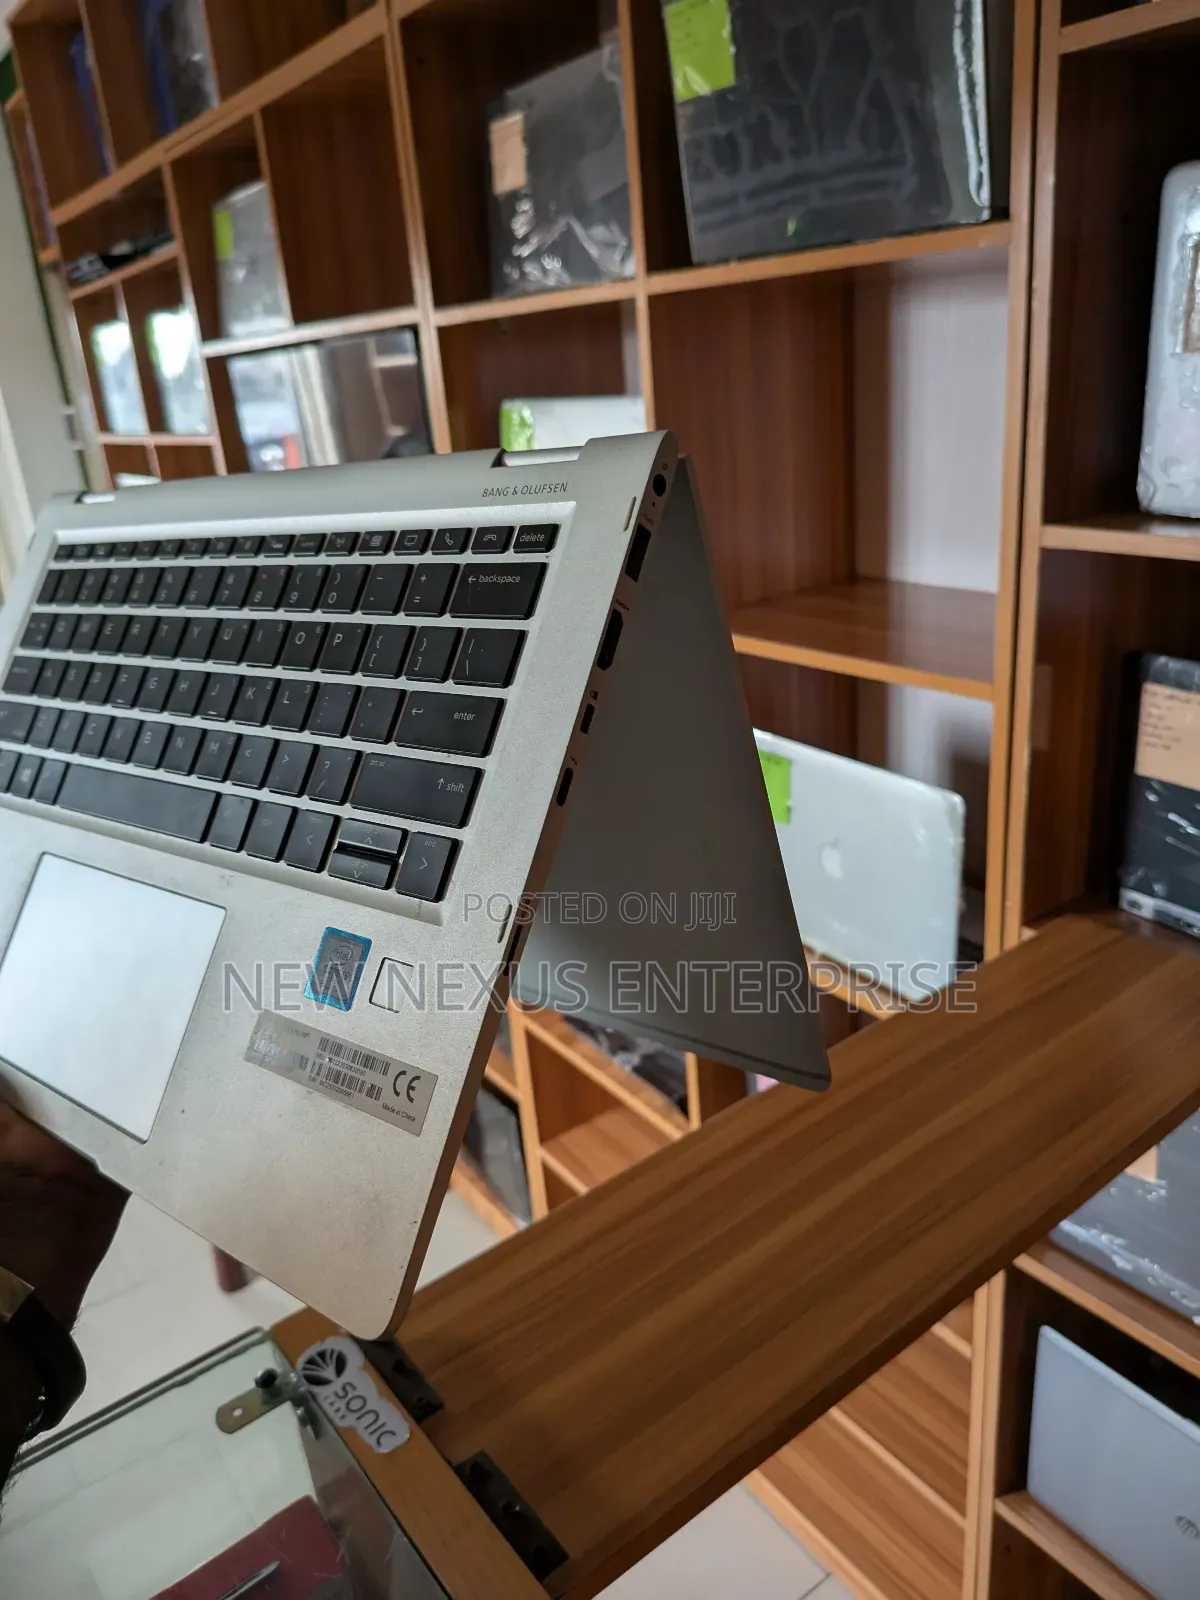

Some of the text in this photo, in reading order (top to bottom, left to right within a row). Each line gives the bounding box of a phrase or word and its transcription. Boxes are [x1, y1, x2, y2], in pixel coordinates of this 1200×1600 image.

[482, 482, 568, 497] BANG & OLUFSEN
[520, 533, 545, 542] delete
[478, 574, 521, 585] backspace
[289, 592, 298, 603] 9
[224, 628, 234, 641] U
[333, 633, 343, 646] P
[369, 653, 377, 667] [
[413, 656, 422, 671] ]
[211, 683, 220, 696] J
[246, 686, 256, 699] K
[283, 690, 290, 704] L
[453, 711, 476, 721] enter
[446, 782, 465, 793] shift
[382, 1103, 396, 1114] Made
[401, 1111, 416, 1122] China
